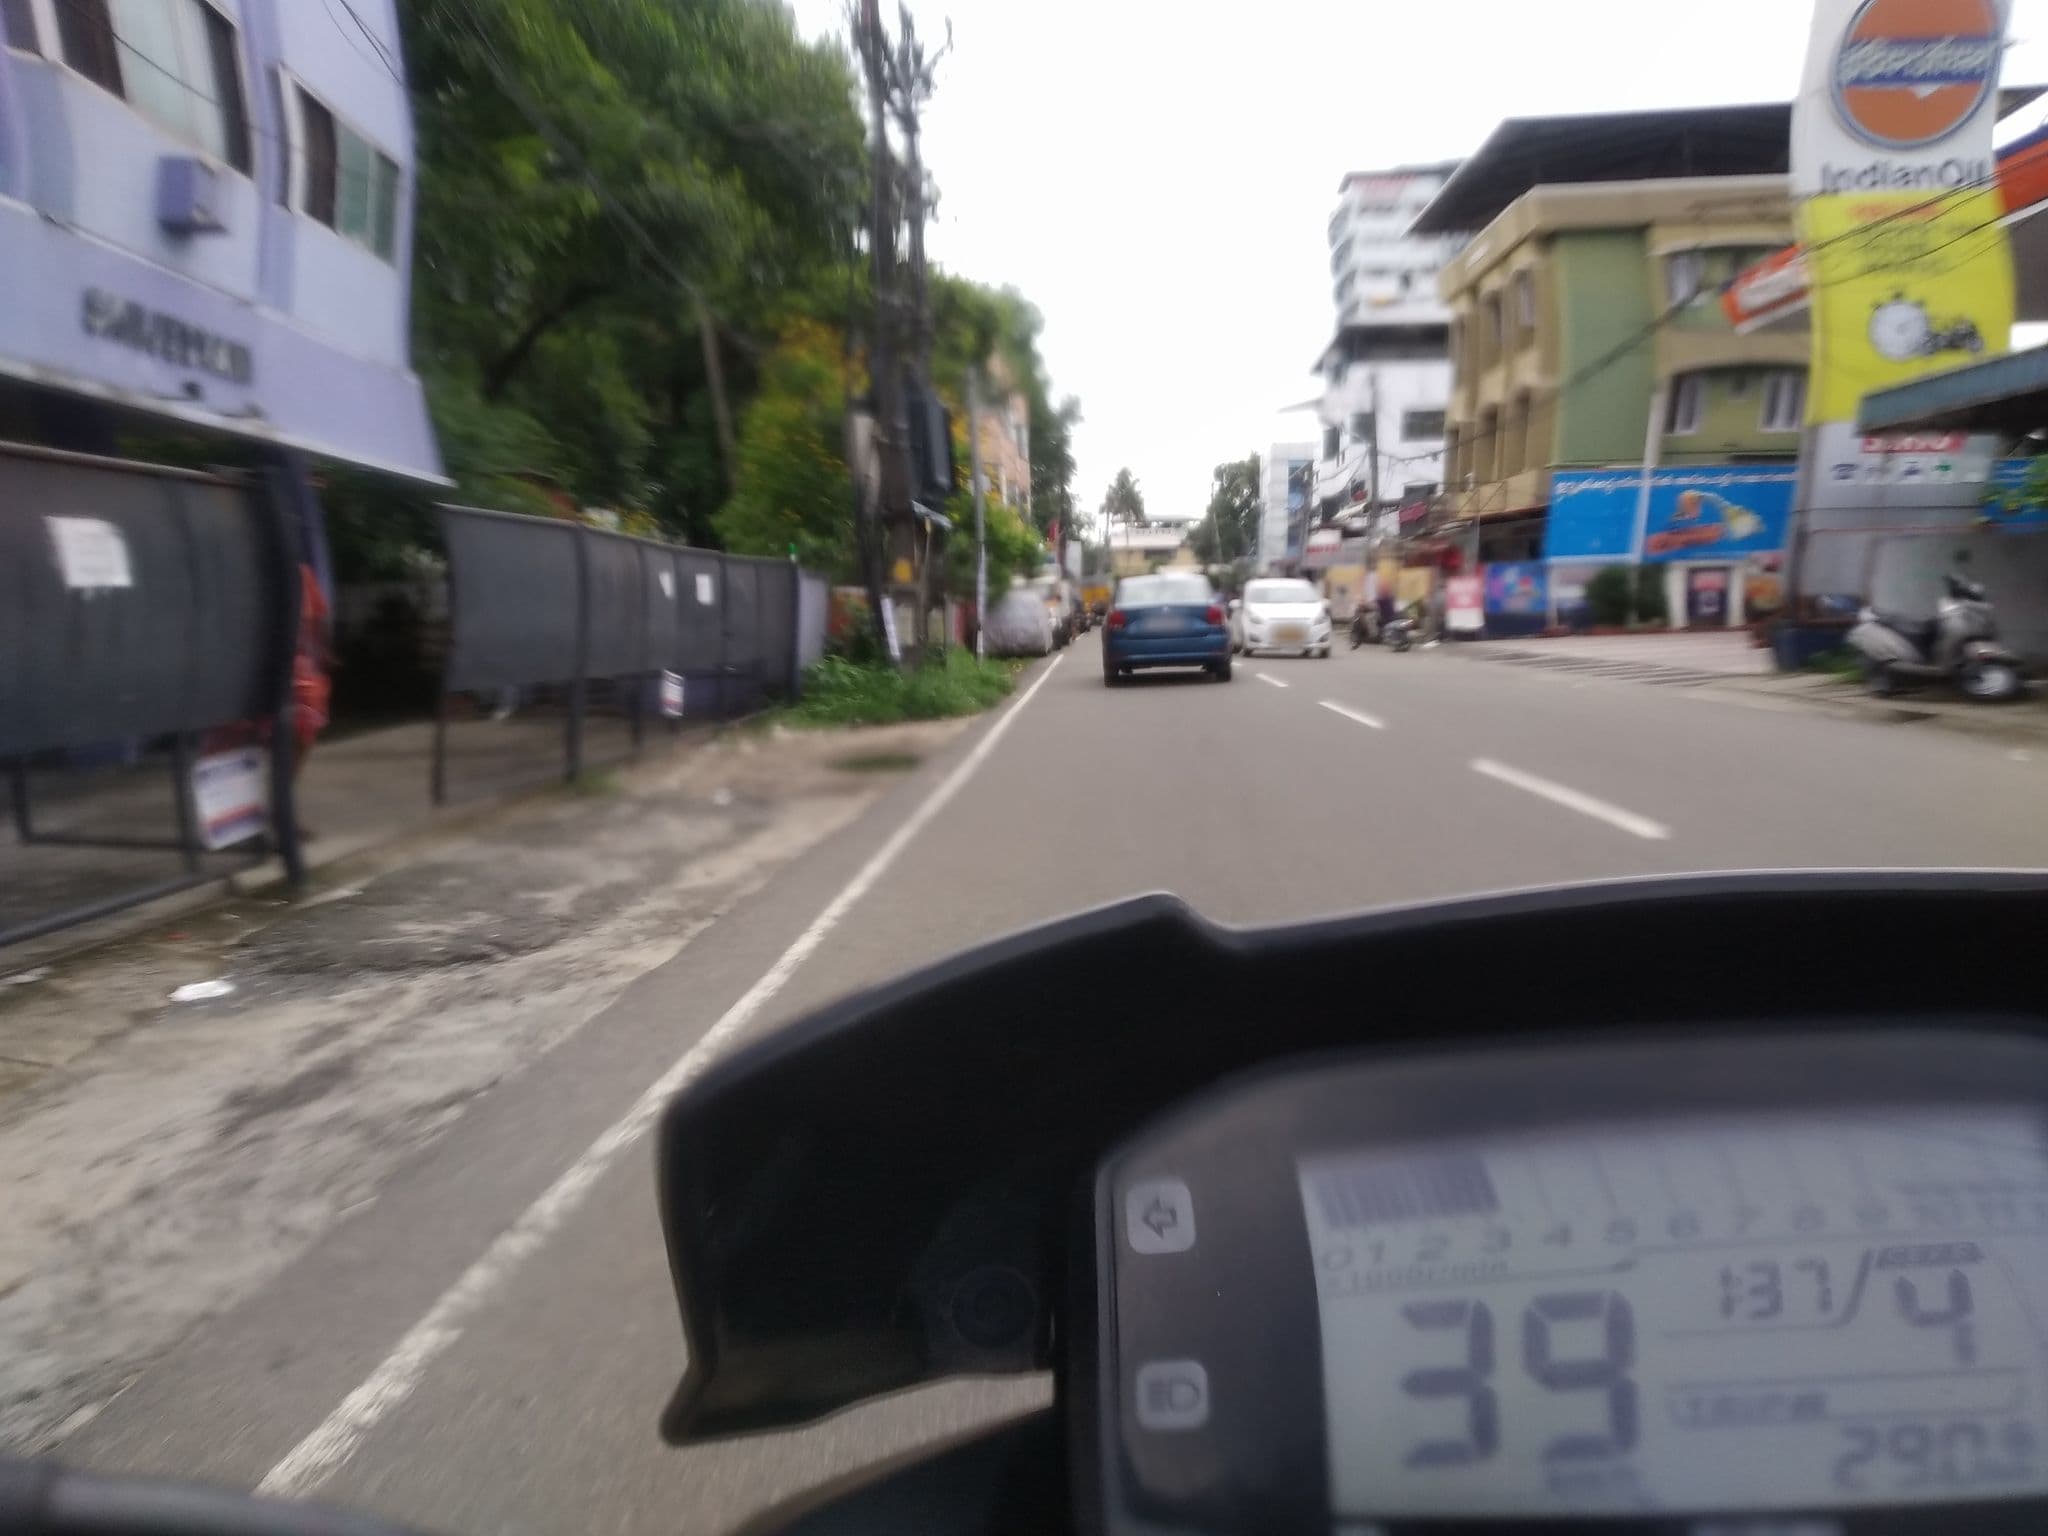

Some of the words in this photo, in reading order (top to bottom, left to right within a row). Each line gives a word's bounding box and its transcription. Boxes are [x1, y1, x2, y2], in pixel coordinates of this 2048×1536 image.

[1820, 158, 1989, 196] IndianOil
[1894, 1268, 1976, 1366] 4
[1400, 1290, 1643, 1470] 39
